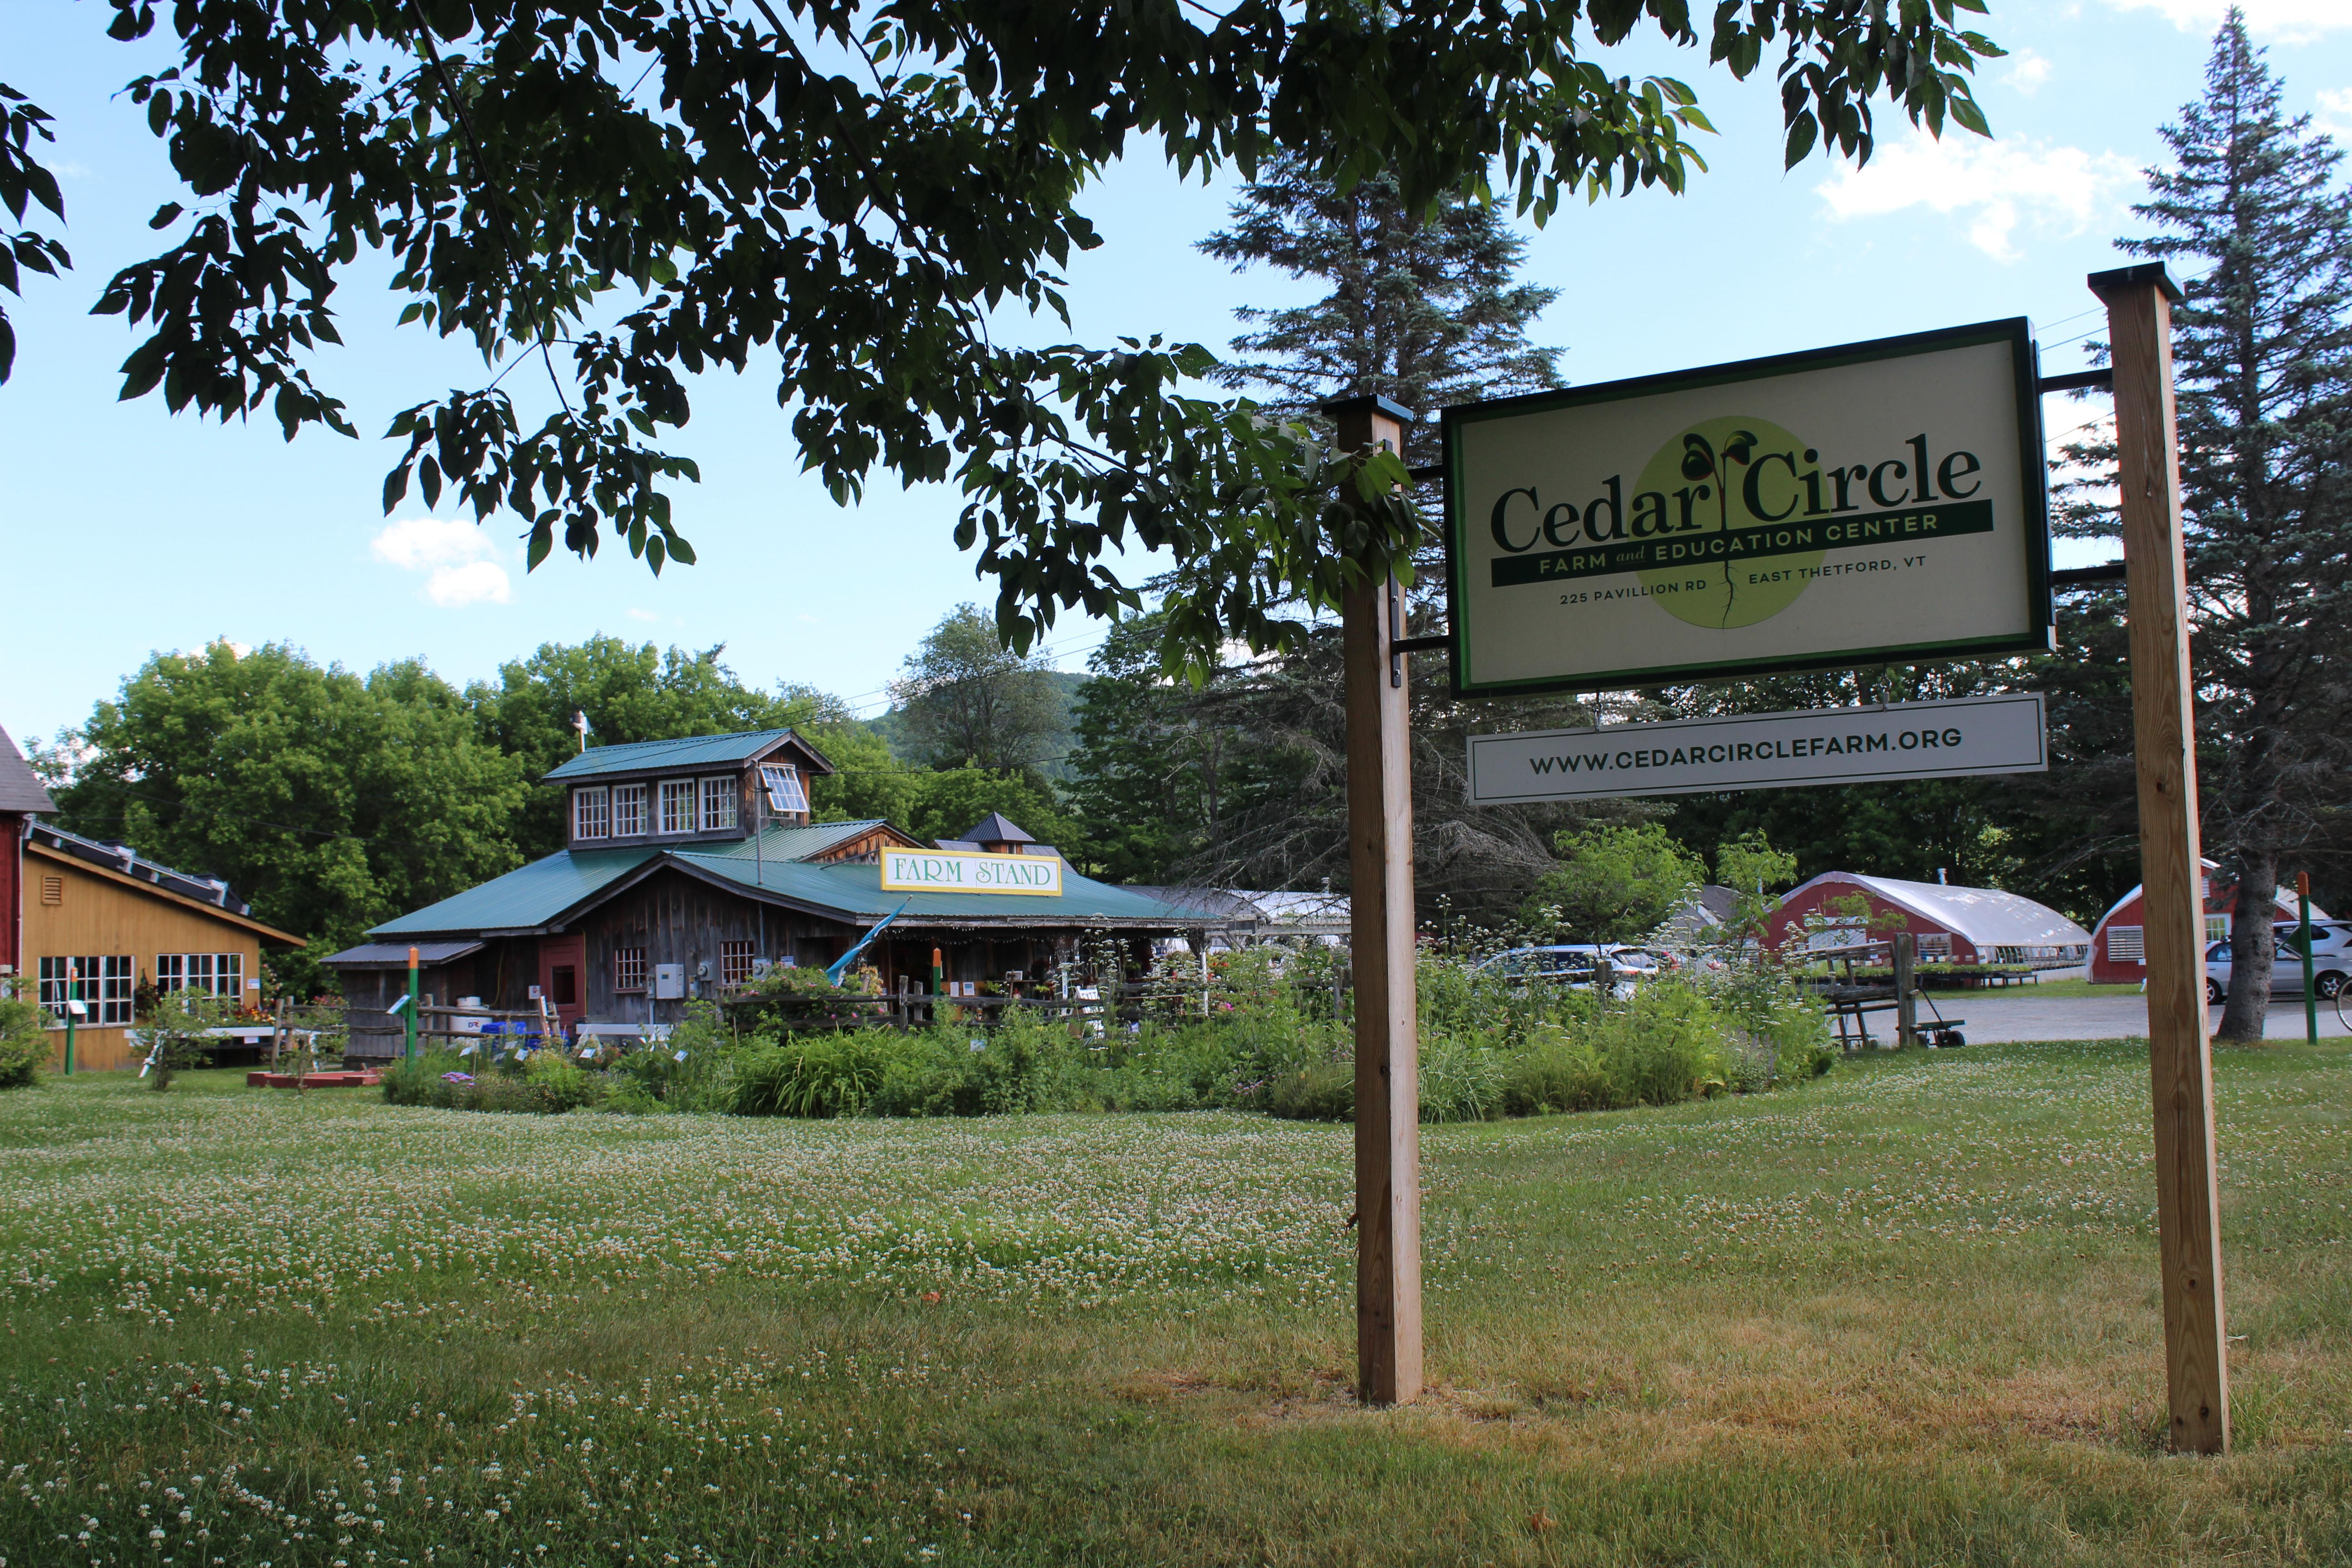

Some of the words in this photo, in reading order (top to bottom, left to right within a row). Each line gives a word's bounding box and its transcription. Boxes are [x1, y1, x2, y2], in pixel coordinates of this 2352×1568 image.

[1491, 475, 1710, 553] Cedar
[1742, 433, 1981, 521] Circle
[1540, 553, 1606, 573] FARM
[1616, 546, 1645, 562] and
[1656, 529, 1812, 560] EDUCATION
[1826, 514, 1937, 540] CENTER
[1749, 570, 1792, 584] EAST
[1798, 559, 1897, 578] THETFORD,
[1904, 556, 1926, 568] VT
[1560, 593, 1587, 604] 225
[1594, 583, 1678, 601] PAVILLION
[1686, 580, 1706, 590] RD
[1529, 728, 1961, 774] WWW.CEDARCIRCLEFARM.ORG
[894, 858, 963, 882] FARM
[976, 862, 1050, 886] STAND
